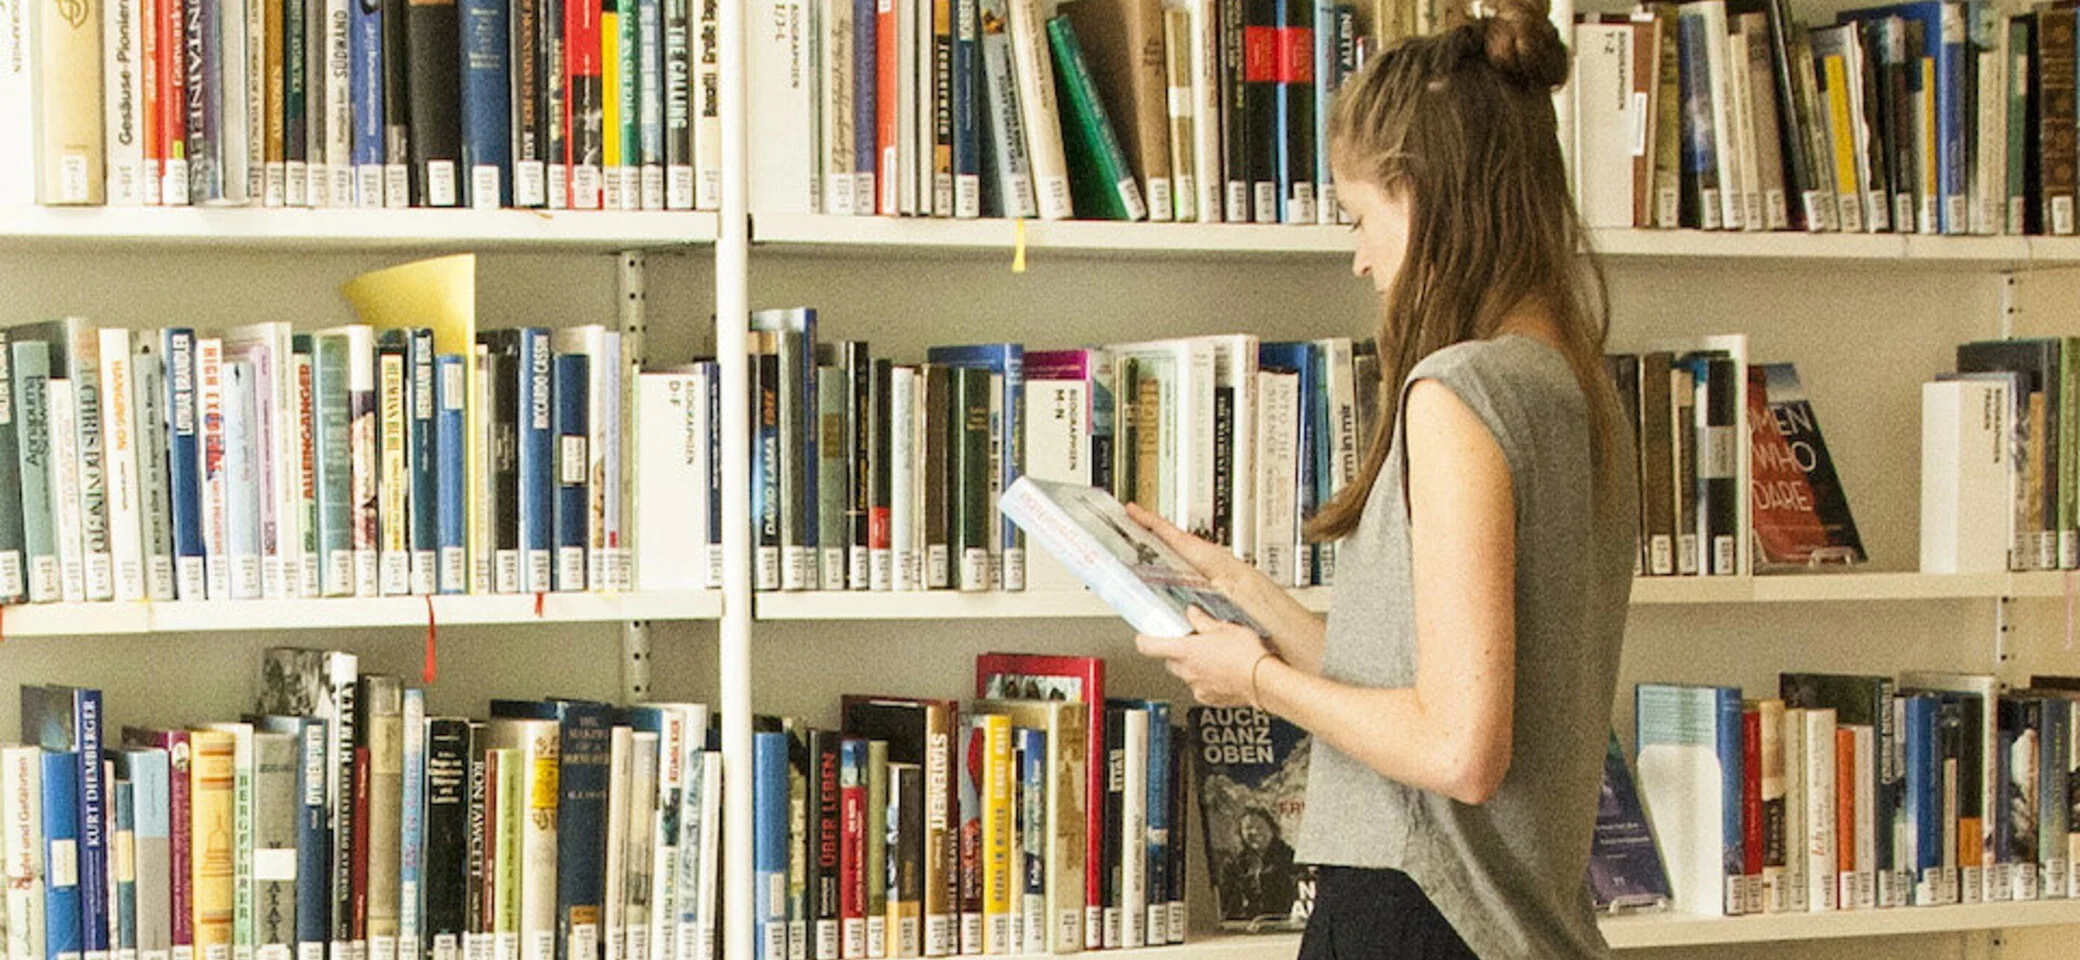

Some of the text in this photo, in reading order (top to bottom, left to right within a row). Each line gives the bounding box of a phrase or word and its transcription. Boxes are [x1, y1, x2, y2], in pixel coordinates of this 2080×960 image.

[333, 9, 348, 78] SÜDWAND
[791, 4, 799, 89] BIOGRAPHIEN
[1341, 13, 1353, 67] ALLEIN
[1617, 31, 1627, 111] BIOGRAPHIEN
[668, 26, 687, 129] THE CALLING
[703, 73, 717, 117] Bonatti
[204, 347, 218, 386] HIGH
[385, 362, 400, 418] HERMANN
[25, 375, 40, 467] Annapurna
[80, 384, 99, 447] CHRIS
[111, 360, 126, 451] HANGING ON
[686, 381, 695, 465] BIOGRAPHIEN
[1068, 389, 1078, 471] BIOGRAPHIEN
[1266, 387, 1276, 456] SILENCE
[1278, 383, 1288, 462] INTO THE
[1341, 403, 1352, 433] mir
[764, 436, 776, 536] DAVID LAMA
[1753, 440, 1816, 473] WHO
[1751, 479, 1813, 512] DARE
[1200, 708, 1270, 727] AUCH
[1202, 727, 1273, 745] GANZ
[83, 700, 101, 846] KURT DIEMBERGER
[931, 733, 947, 831] STATEMENT
[1203, 745, 1275, 765] OBEN
[472, 761, 484, 878] RON FAWCETT
[821, 752, 836, 867] ÜBER LEBEN
[1279, 801, 1304, 816] FR
